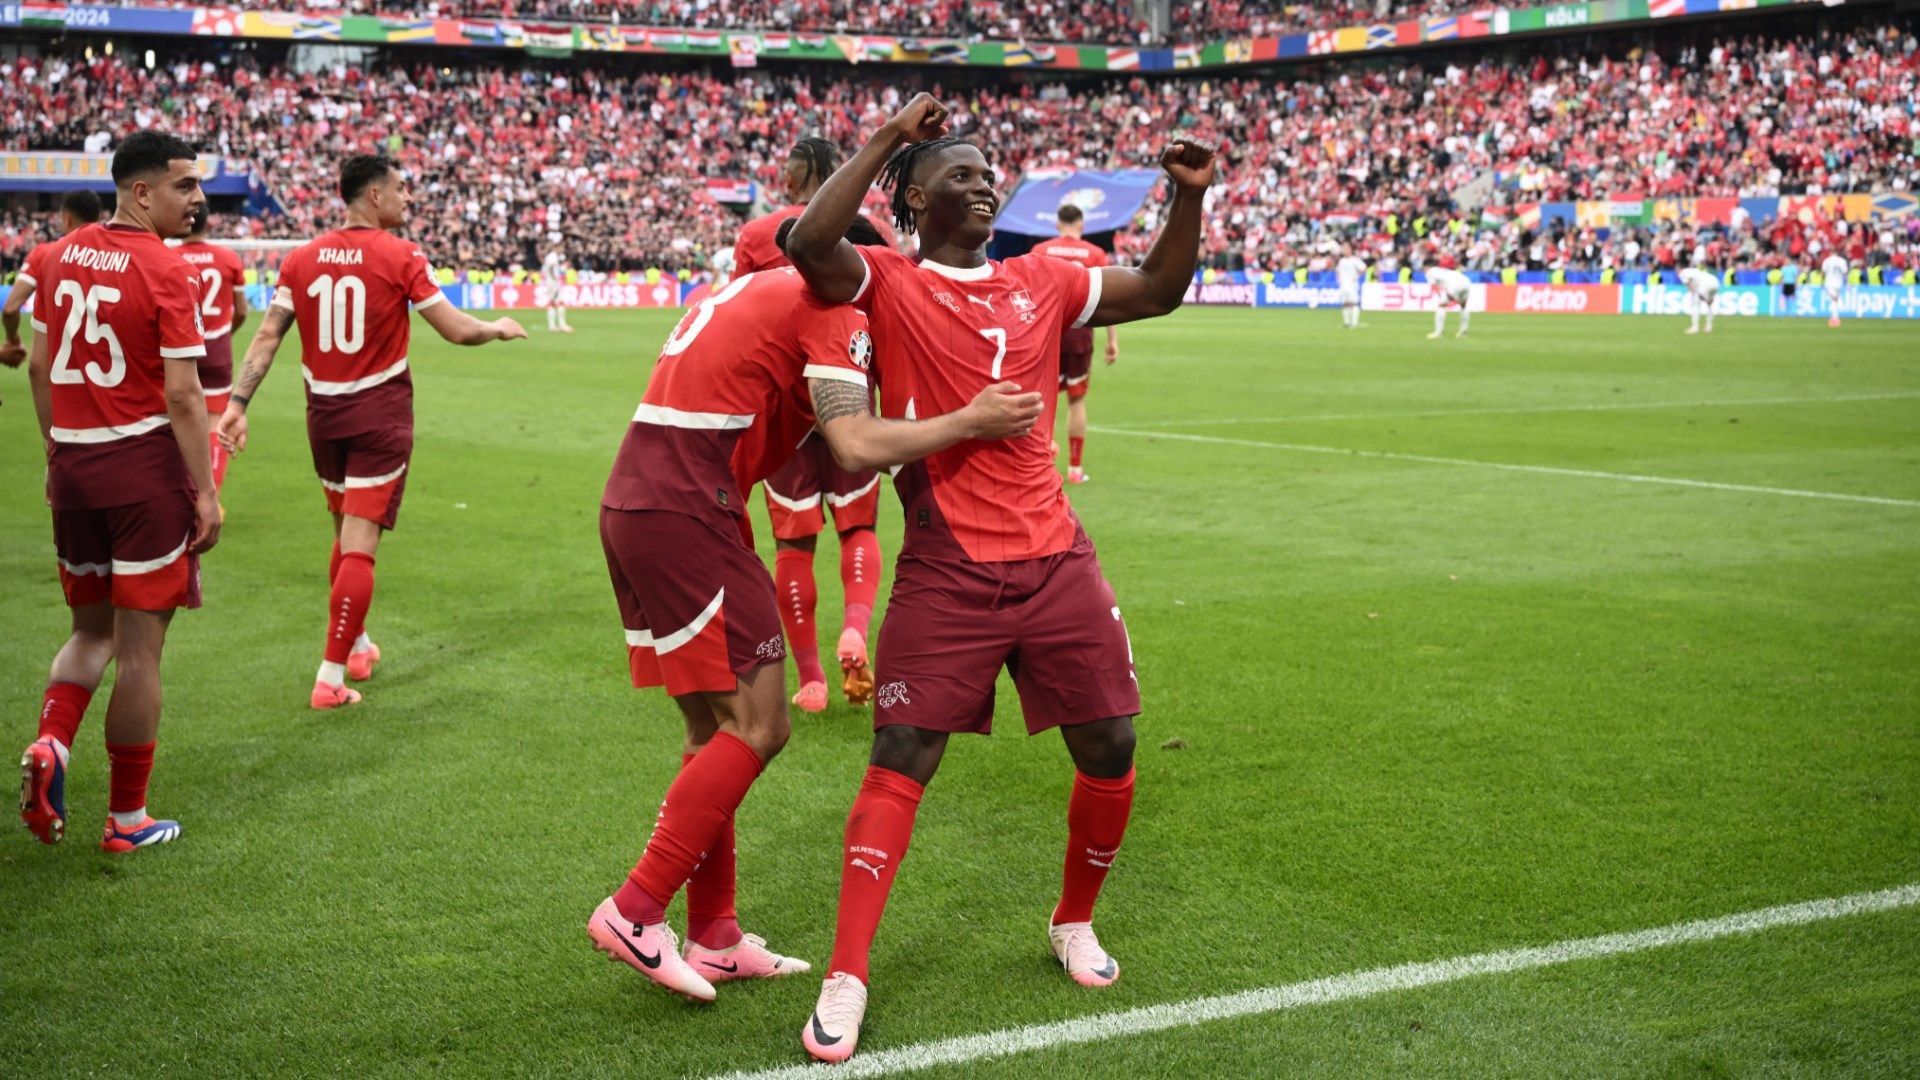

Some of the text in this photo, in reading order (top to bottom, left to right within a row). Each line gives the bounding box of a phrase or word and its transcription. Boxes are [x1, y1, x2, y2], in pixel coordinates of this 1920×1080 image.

[65, 8, 110, 25] 2024
[60, 244, 130, 273] AMDOUNI
[317, 248, 363, 265] XHAKA
[201, 268, 222, 316] 2
[533, 285, 640, 307] SRAUSS
[1632, 284, 1759, 316] Hisese
[307, 274, 366, 354] 10
[50, 279, 126, 388] 25
[979, 328, 1006, 380] 7
[849, 846, 889, 860] SUISSE
